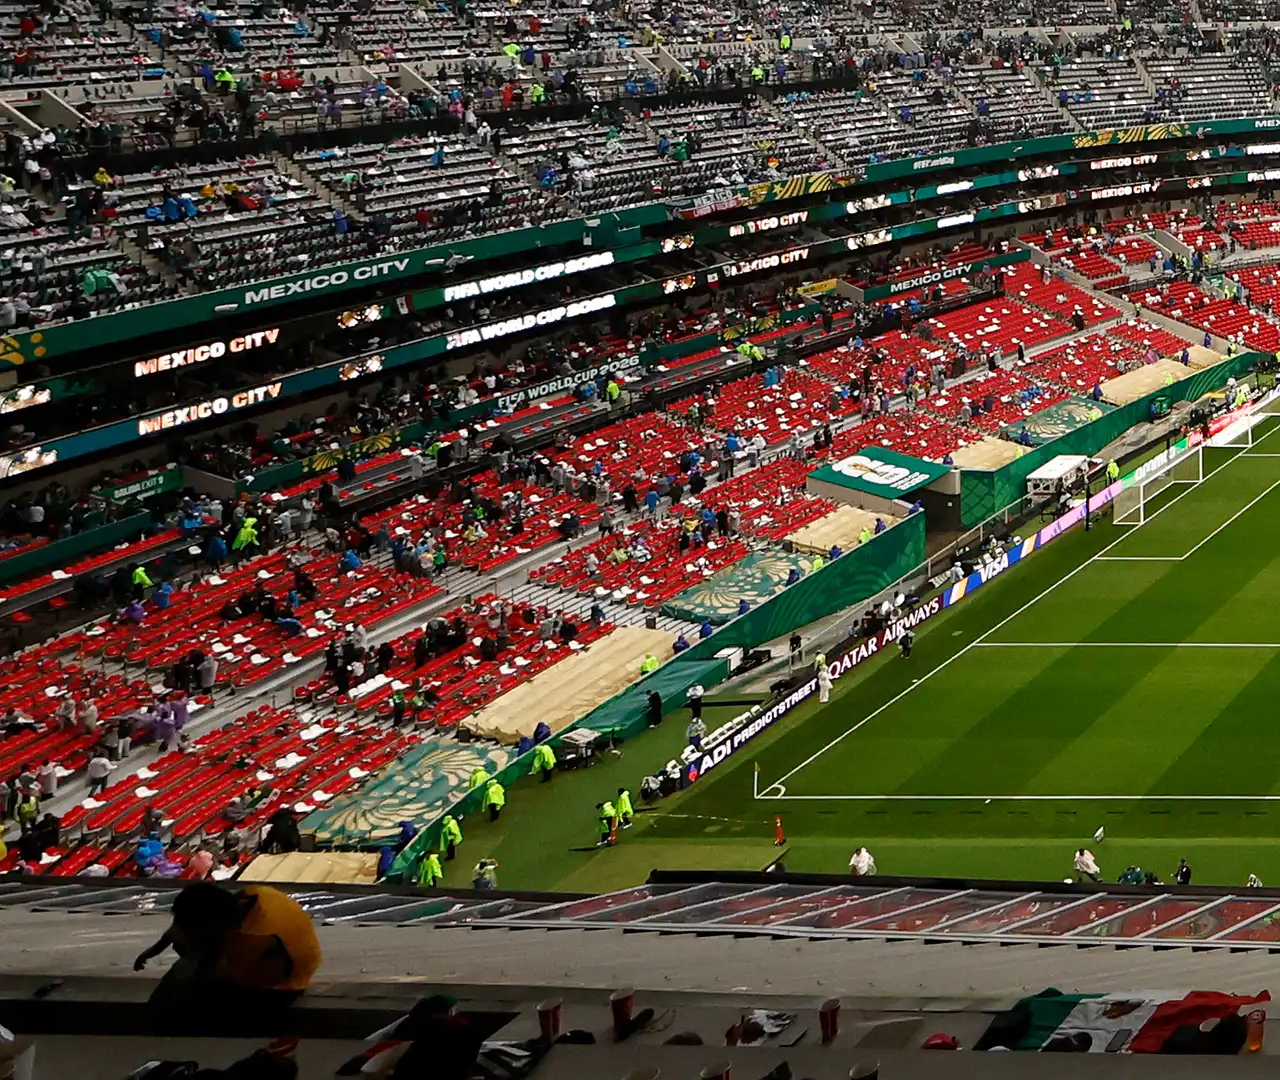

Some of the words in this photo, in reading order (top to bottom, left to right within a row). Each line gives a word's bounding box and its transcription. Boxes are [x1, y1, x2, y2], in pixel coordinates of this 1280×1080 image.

[245, 271, 349, 305] MEXICO
[354, 258, 411, 280] CITY
[444, 280, 480, 302] FIFA
[480, 268, 535, 295] WORLD
[535, 262, 565, 282] CUP
[890, 272, 941, 293] MEXICO
[942, 263, 973, 280] CITY
[481, 312, 536, 340] WORLD
[536, 306, 566, 326] CUP
[134, 340, 226, 377] MEXICO
[229, 328, 280, 353] CITY
[498, 391, 527, 410] FIFA
[527, 377, 573, 401] WORLD
[574, 368, 598, 384] CUP
[599, 355, 640, 377] 2026
[138, 398, 229, 436] MEXICO
[232, 382, 282, 408] CITY
[141, 477, 157, 490] EXIT
[980, 551, 1009, 583] VISA
[826, 636, 879, 680] QATAR
[881, 596, 940, 645] AIRWAYS
[700, 738, 732, 775] ADI
[734, 677, 818, 748] PREDICTSTREET
